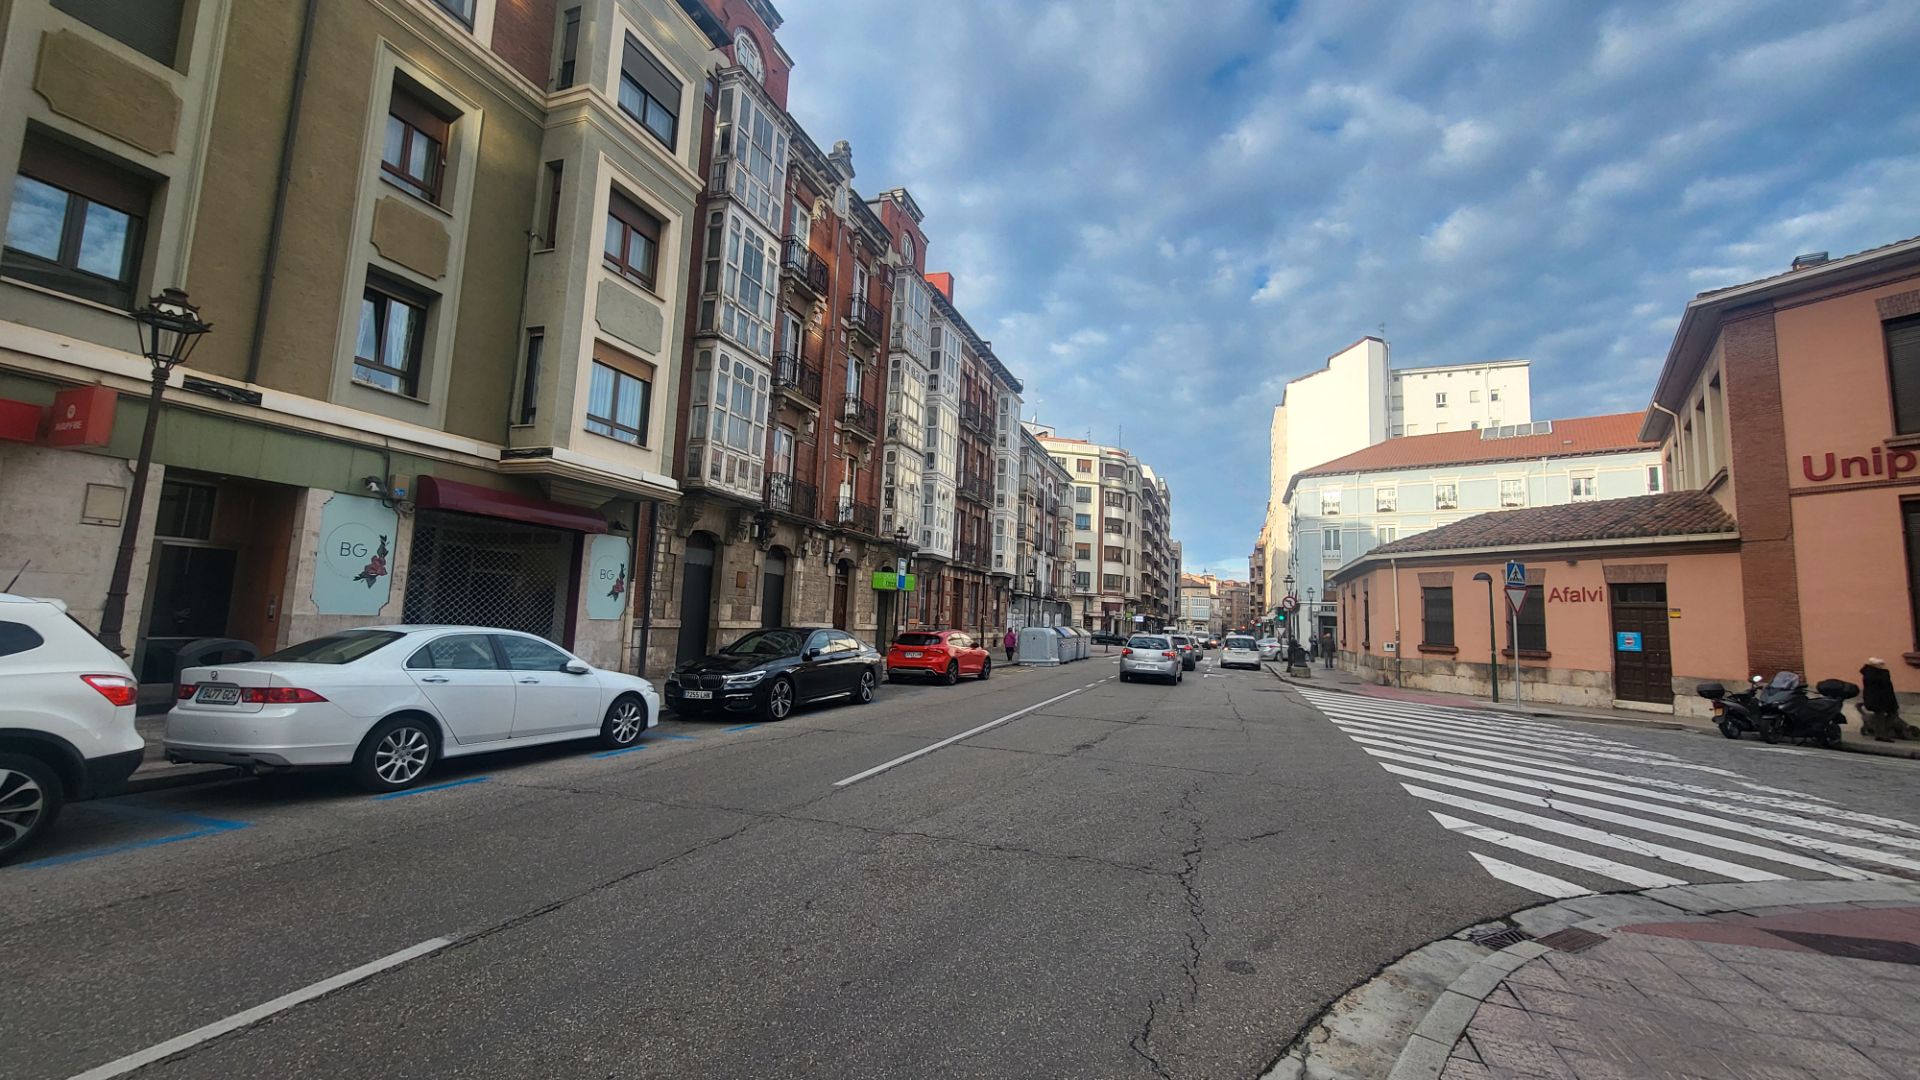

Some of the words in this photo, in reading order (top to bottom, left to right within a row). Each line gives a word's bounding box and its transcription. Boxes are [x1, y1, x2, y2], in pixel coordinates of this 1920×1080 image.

[340, 541, 368, 557] BG
[599, 568, 616, 580] BG
[1548, 586, 1603, 603] Afalvi
